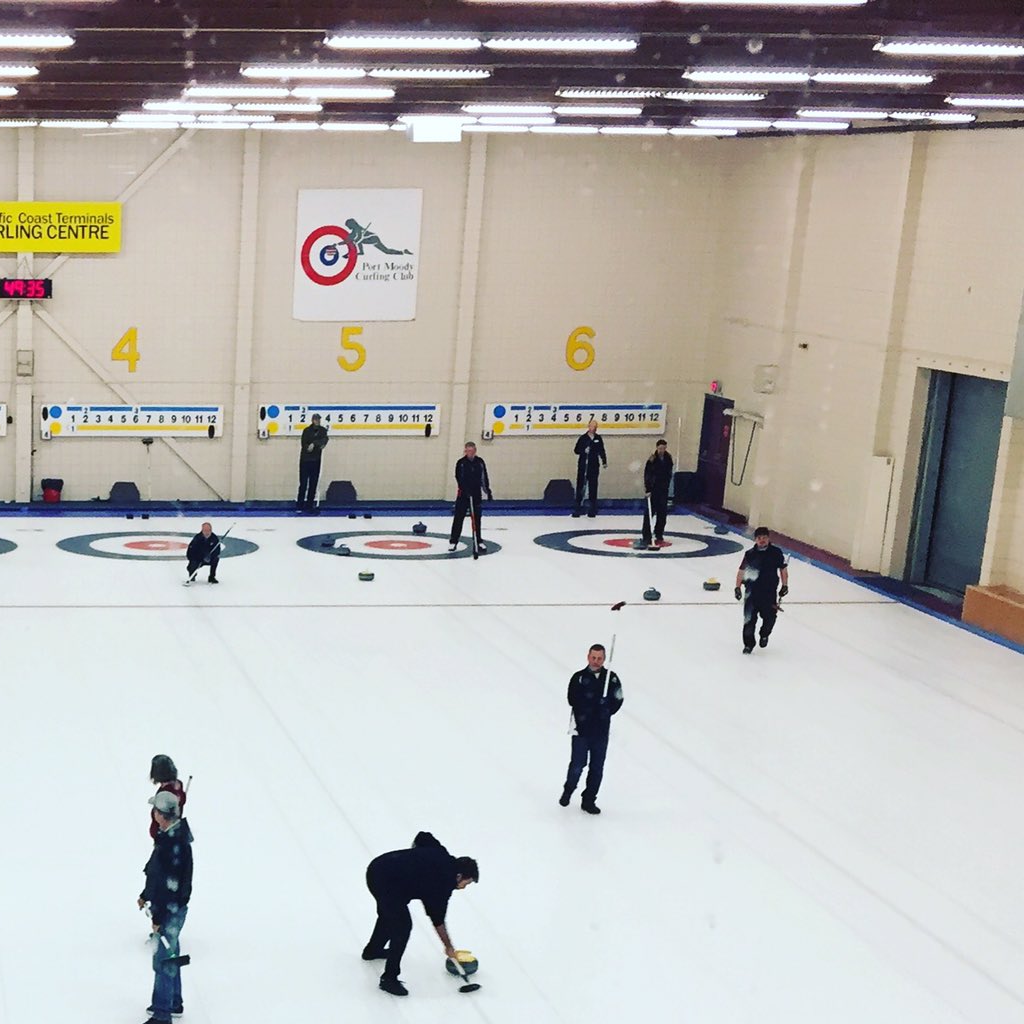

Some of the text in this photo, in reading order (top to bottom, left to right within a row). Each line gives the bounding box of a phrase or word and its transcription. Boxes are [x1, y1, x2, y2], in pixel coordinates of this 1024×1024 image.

[18, 212, 53, 224] Coast
[56, 213, 114, 225] Terminals
[47, 225, 110, 239] CENTRE
[362, 262, 414, 271] Port Moody
[355, 272, 414, 281] Curling Club
[3, 280, 45, 298] 49:35
[112, 328, 140, 372] 4
[338, 327, 366, 371] 5
[566, 326, 595, 370] 6
[71, 415, 217, 423] 1 2 3 4 5 6 7 8 9 10 11 12
[288, 414, 433, 423] 1 2 4 5 6 7 8 9 10 11 12
[514, 414, 519, 422] 1
[525, 414, 532, 422] 2
[538, 414, 544, 422] 3
[550, 414, 557, 422] 4
[563, 414, 569, 422] 5
[576, 414, 582, 422] 6
[601, 414, 608, 422] 8
[614, 414, 620, 422] 9
[624, 414, 634, 422] 10
[637, 414, 646, 422] 11
[649, 413, 660, 421] 12
